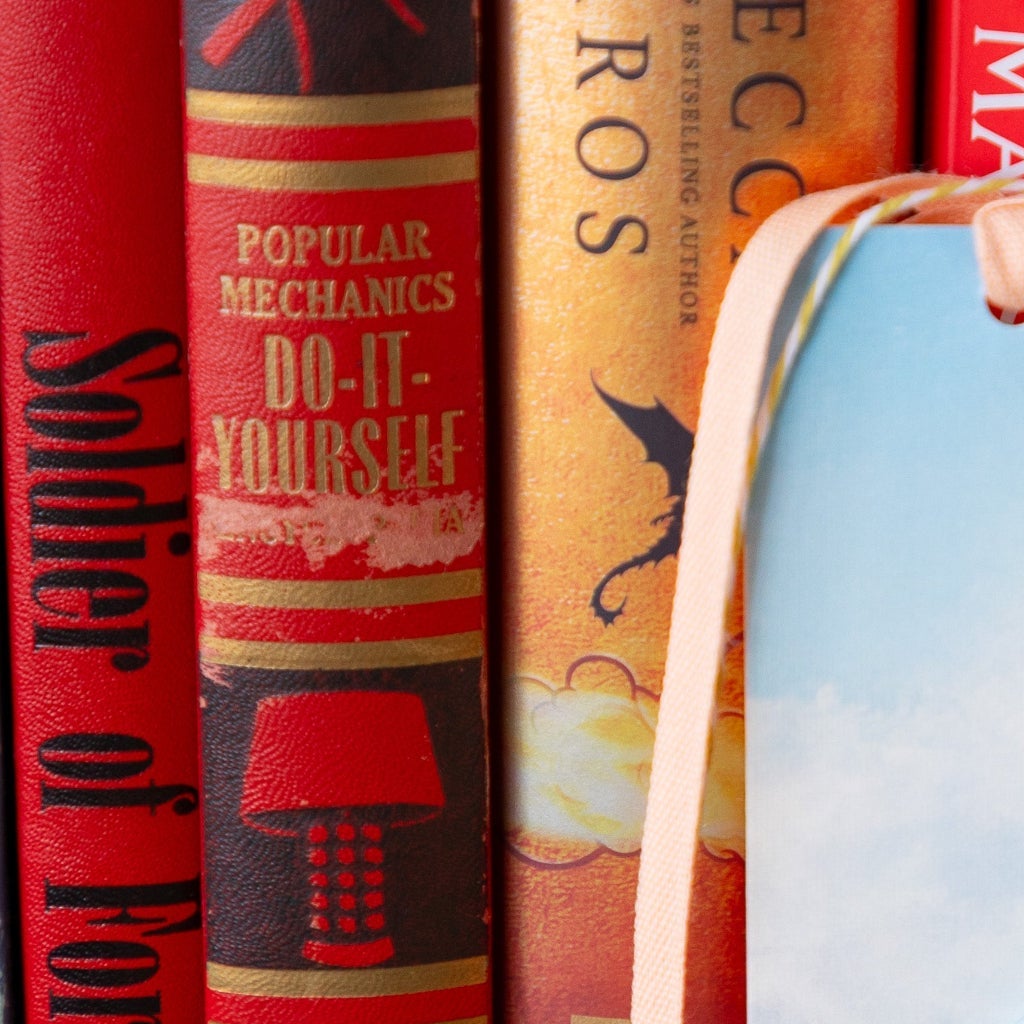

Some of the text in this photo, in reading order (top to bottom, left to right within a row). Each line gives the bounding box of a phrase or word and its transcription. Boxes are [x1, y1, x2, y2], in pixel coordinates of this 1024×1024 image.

[575, 0, 650, 255] ROS
[680, 23, 700, 206] BESTSELLING
[730, 0, 806, 264] ECC
[236, 220, 432, 267] POPULAR
[679, 217, 698, 327] AUTHOR
[219, 271, 457, 321] MECHANICS
[264, 330, 431, 412] DO-IT-
[22, 328, 191, 672] Soldier
[212, 409, 466, 496] YOURSELF
[37, 732, 199, 816] of
